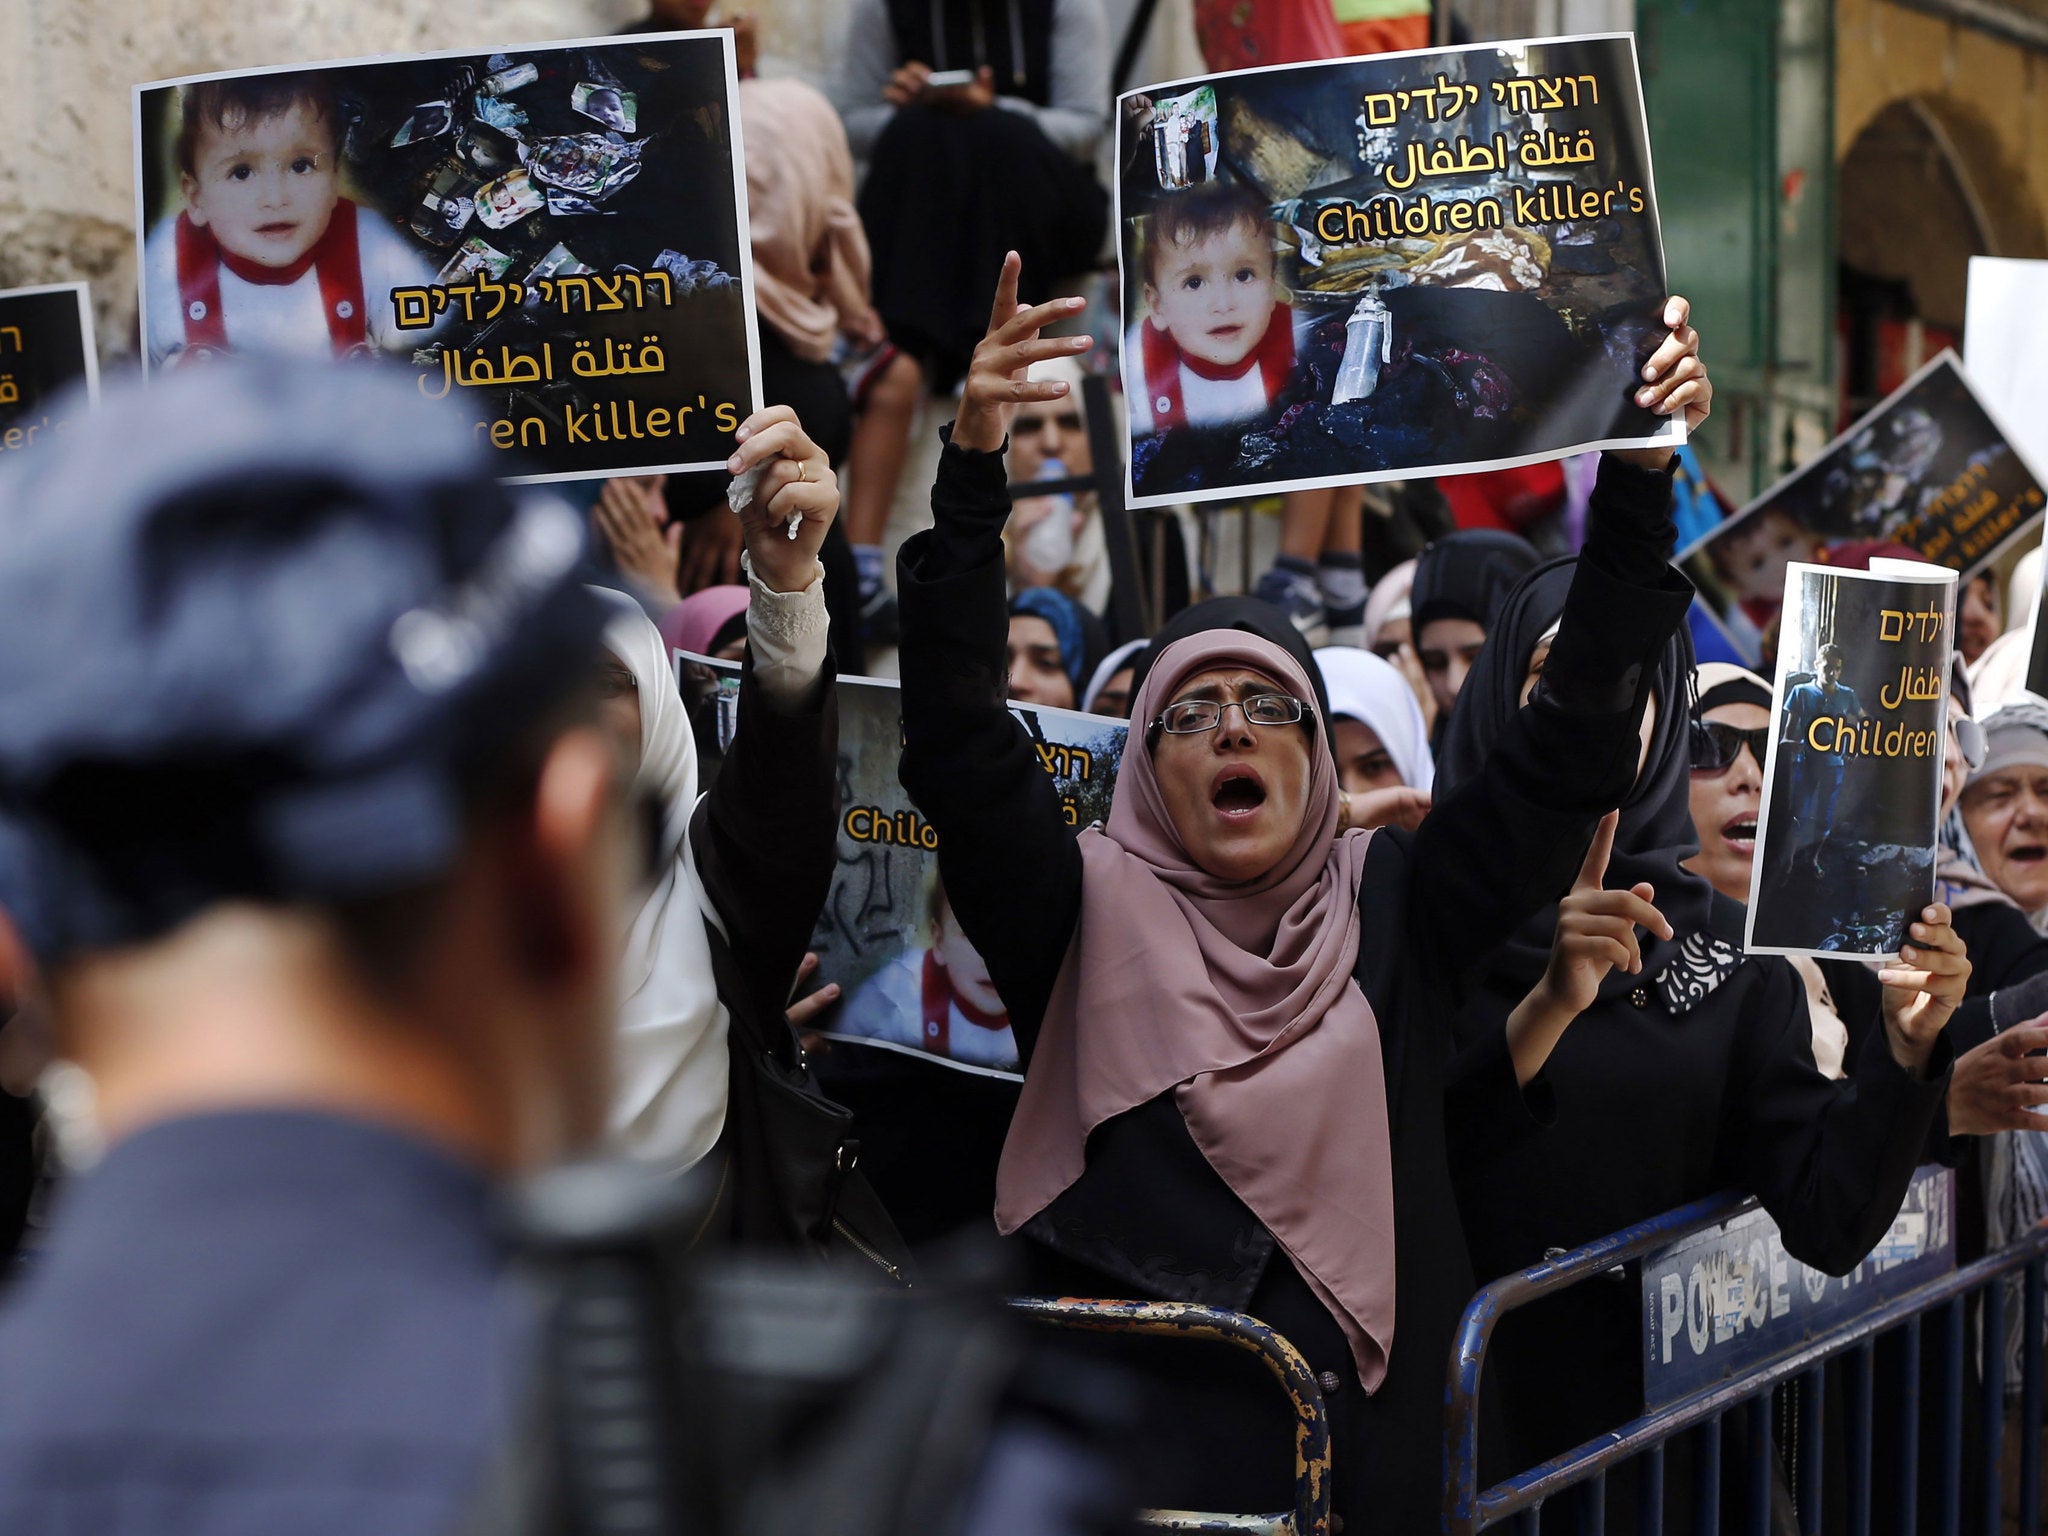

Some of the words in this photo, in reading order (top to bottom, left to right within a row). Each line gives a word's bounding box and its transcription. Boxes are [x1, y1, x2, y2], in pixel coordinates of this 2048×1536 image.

[1363, 74, 1480, 126] ילדים
[1491, 74, 1599, 113] רוצחי
[1385, 134, 1507, 189] اطفال
[1519, 129, 1596, 167] قتلة
[1316, 197, 1501, 242] Children
[1513, 180, 1644, 225] killer's
[394, 272, 525, 327] ילדים
[540, 271, 673, 314] רוצחי
[416, 342, 553, 401] اطفال
[571, 335, 666, 378] قتلة
[564, 394, 739, 445] killer's
[1879, 600, 1944, 644] ילדים
[1880, 665, 1943, 710] طفال
[1807, 715, 1938, 758] Children
[1035, 743, 1090, 780] רוצ
